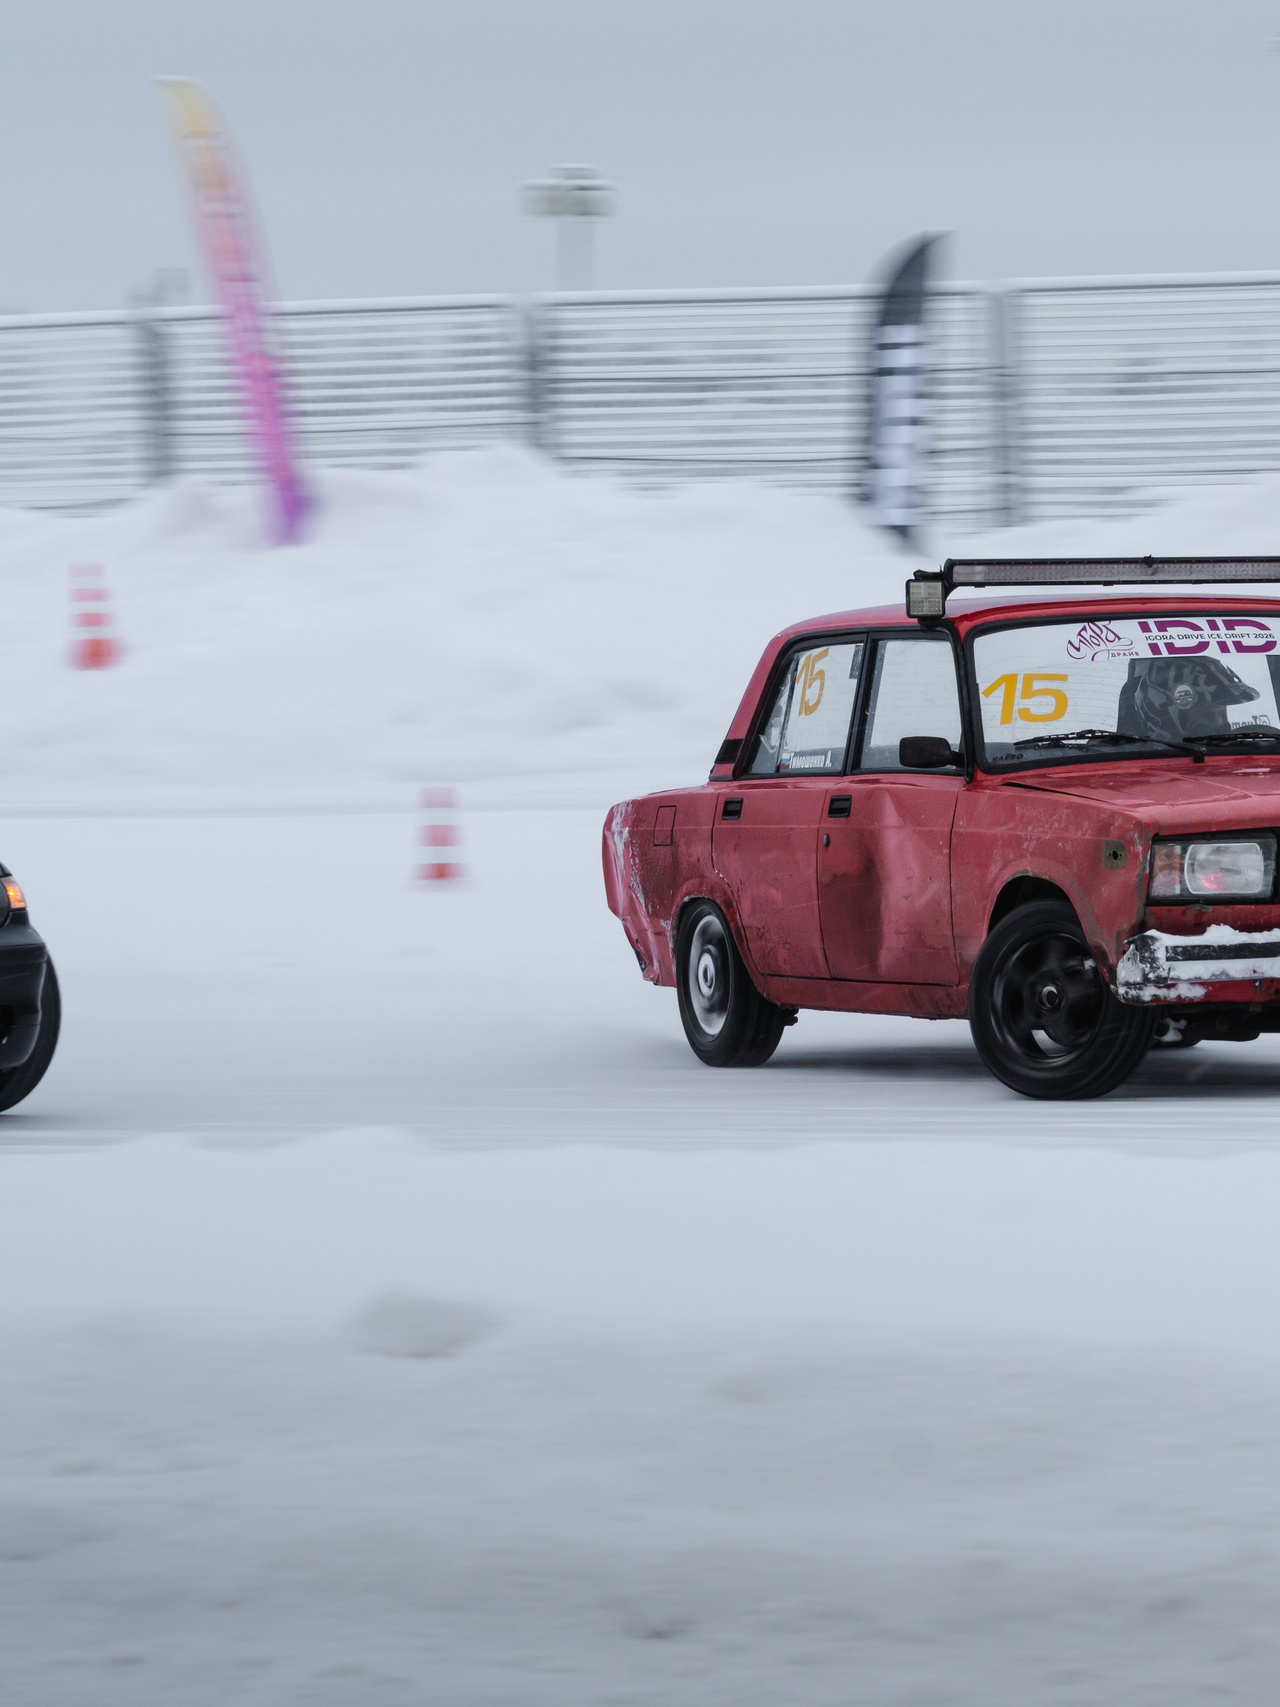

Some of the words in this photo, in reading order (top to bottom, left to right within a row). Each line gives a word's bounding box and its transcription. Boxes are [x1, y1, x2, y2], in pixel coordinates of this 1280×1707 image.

[1145, 634, 1176, 642] IGORA
[1177, 633, 1206, 641] DRIVE
[1207, 632, 1223, 640] ICE
[1225, 632, 1251, 640] DRIFT
[1111, 650, 1140, 659] ДРАЙВ
[795, 647, 829, 718] 15
[981, 672, 1069, 726] 15
